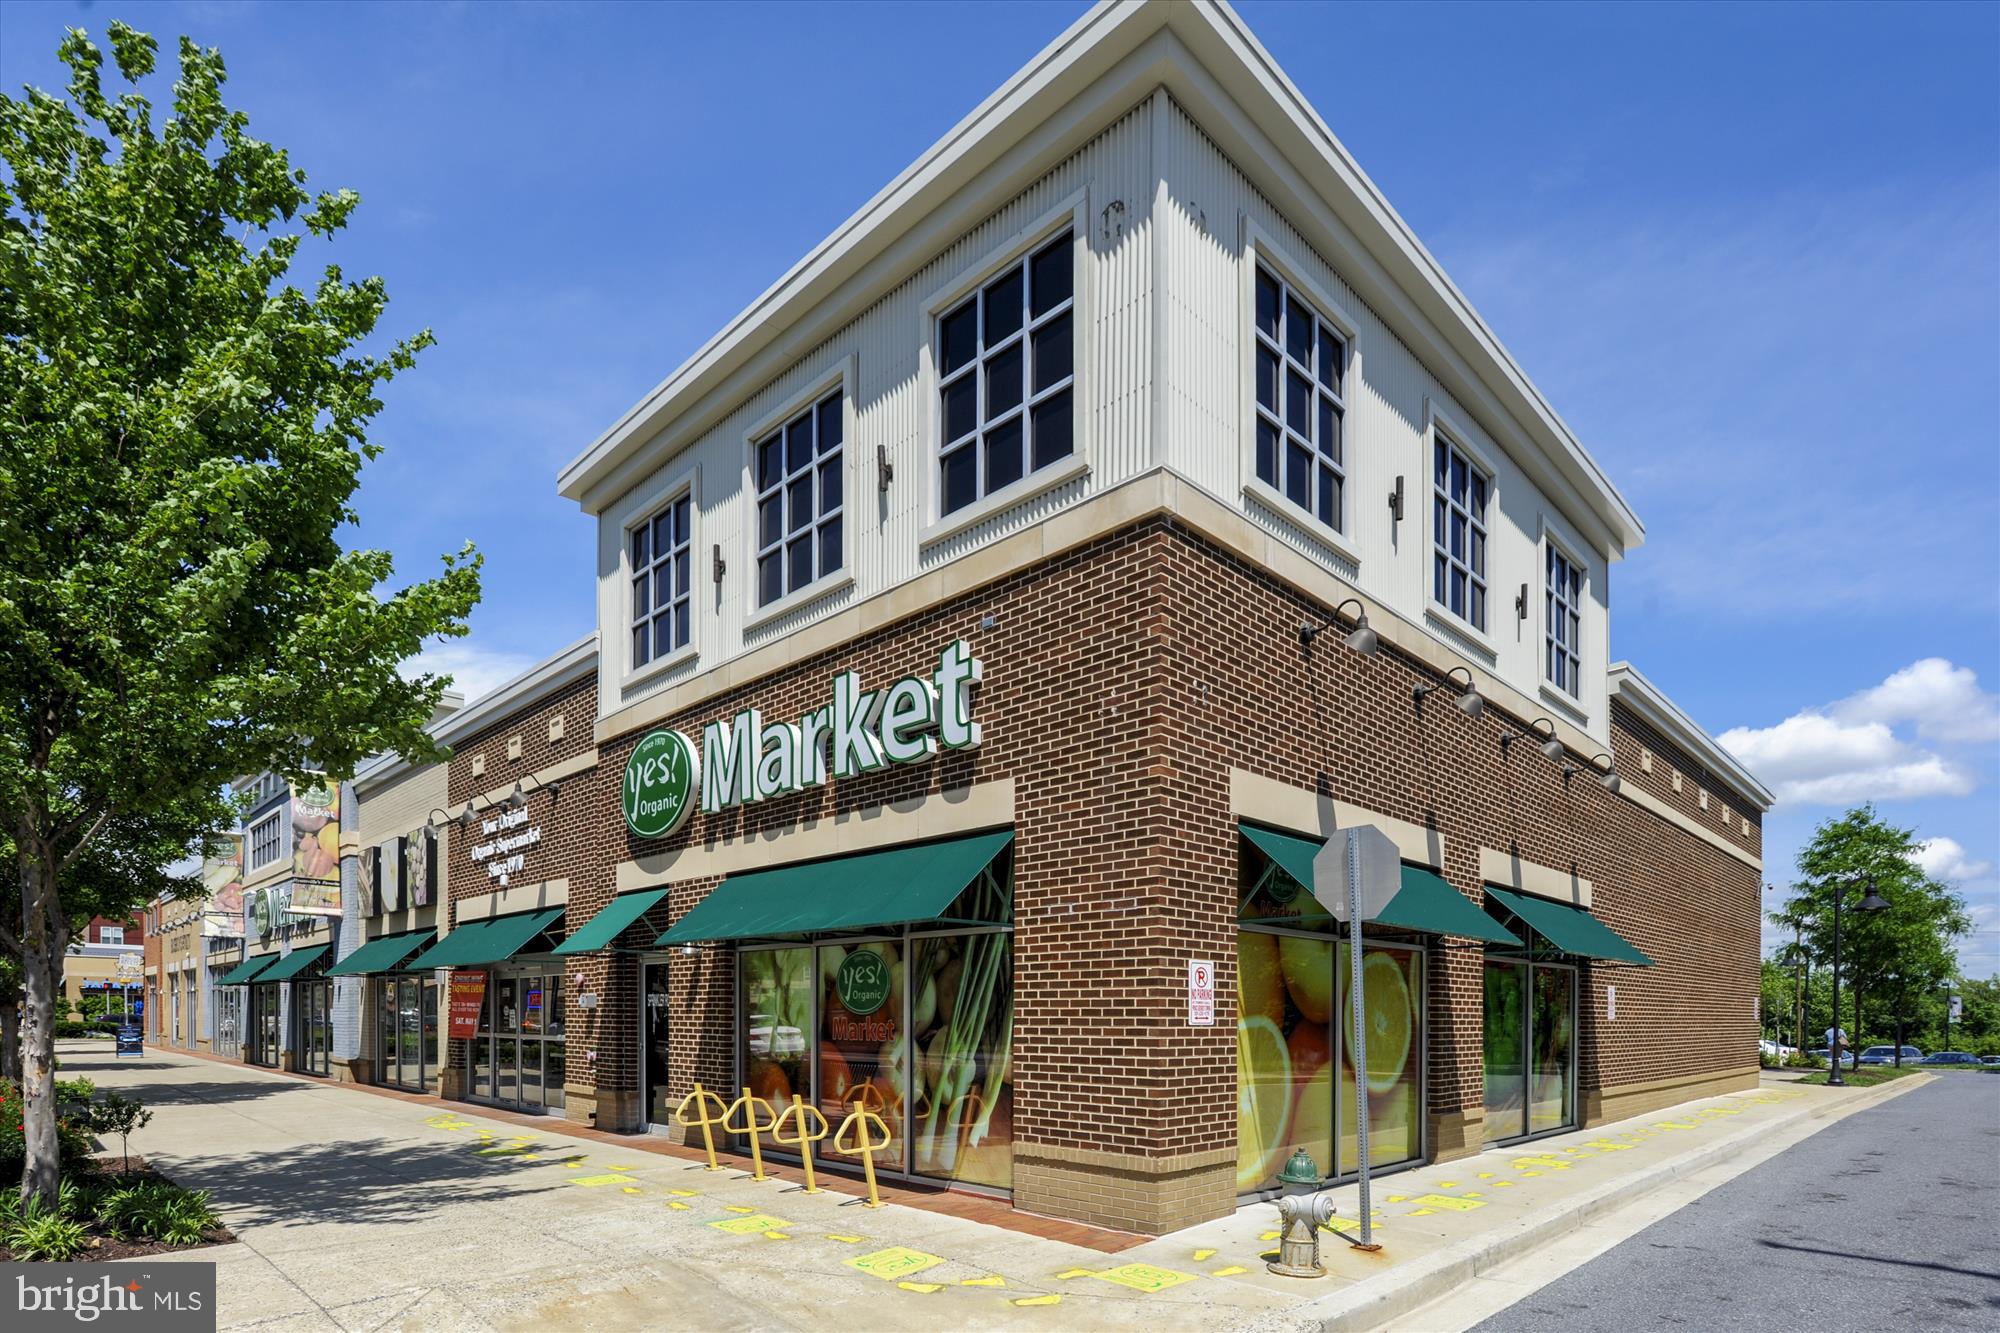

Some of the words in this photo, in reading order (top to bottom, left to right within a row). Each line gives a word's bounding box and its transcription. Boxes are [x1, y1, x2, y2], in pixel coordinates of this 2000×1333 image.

[701, 639, 983, 814] Market
[642, 741, 654, 752] Since
[654, 737, 666, 746] 1970
[629, 743, 679, 823] yes!
[296, 802, 336, 819] Market
[640, 793, 678, 817] Organic
[499, 806, 528, 829] Original
[496, 826, 541, 853] Supermarket
[489, 862, 507, 877] Since
[507, 854, 523, 873] 1970
[452, 984, 470, 993] TASTING
[471, 984, 485, 993] EVENT
[843, 962, 881, 1002] yes!
[852, 990, 881, 1002] Organic
[1191, 989, 1197, 1000] NO
[1197, 989, 1212, 1000] PARKING
[832, 1016, 896, 1042] Market
